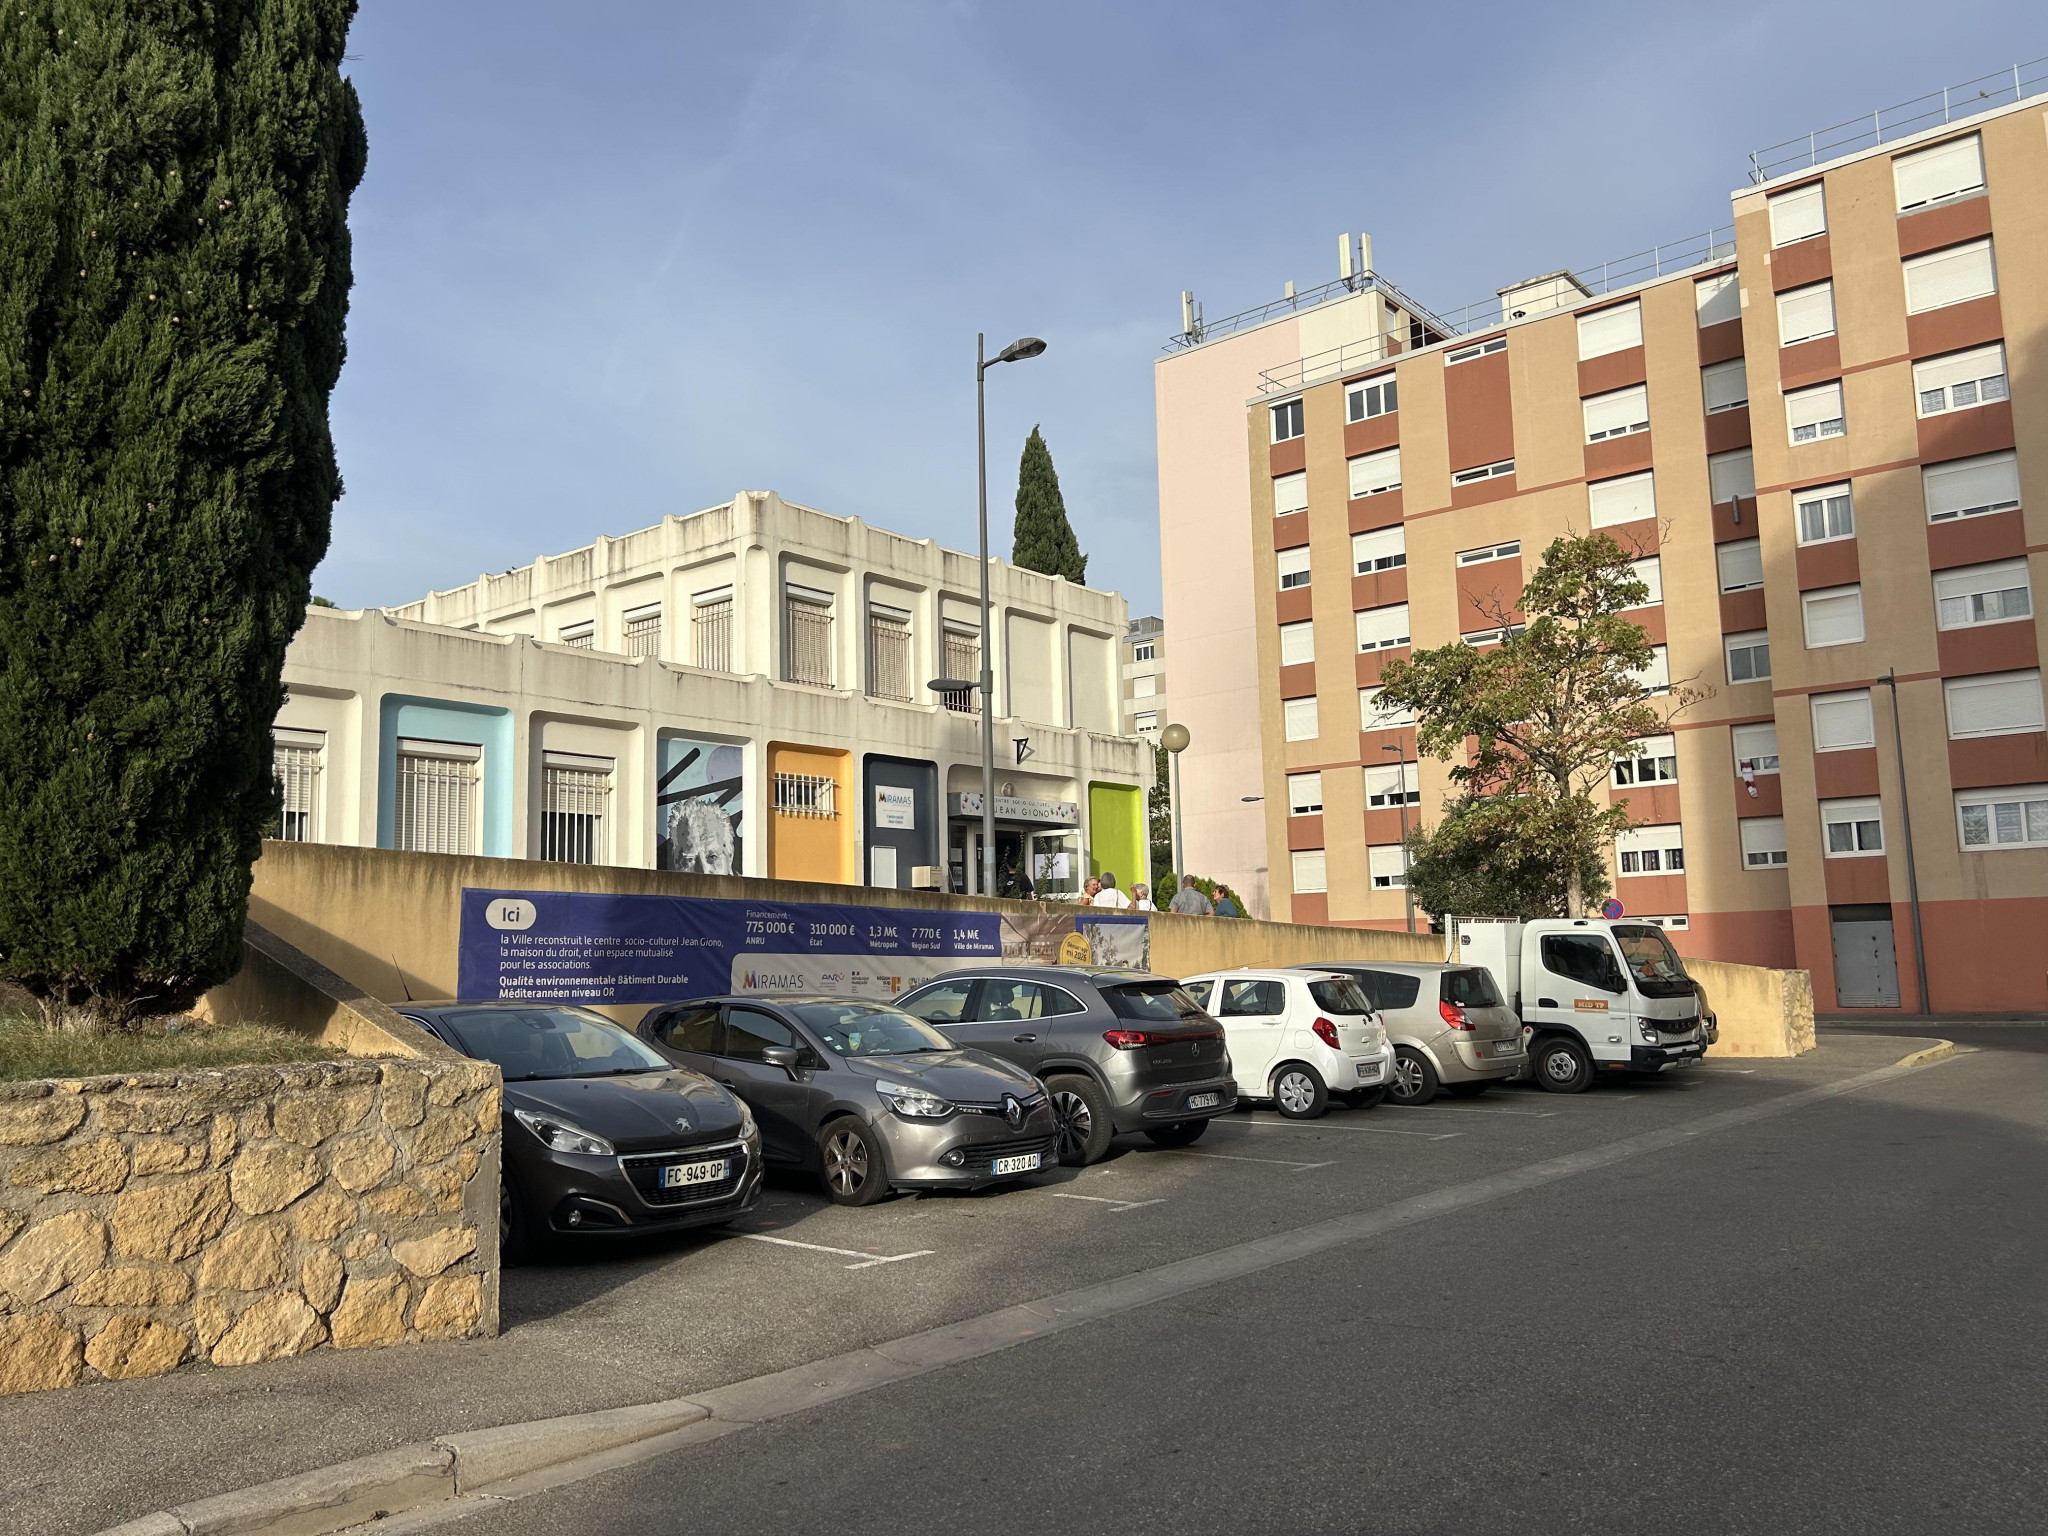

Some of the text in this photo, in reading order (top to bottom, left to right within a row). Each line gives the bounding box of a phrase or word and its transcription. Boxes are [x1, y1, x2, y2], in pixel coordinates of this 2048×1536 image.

[879, 792, 912, 805] MIRAMAS
[994, 806, 1050, 818] JEAN GIONO
[502, 906, 520, 922] Ici
[746, 921, 795, 934] 775 000 €
[810, 923, 855, 936] 310 000 €
[869, 926, 898, 938] 1,3 M€
[919, 928, 934, 939] 770
[935, 928, 941, 939] €
[501, 934, 724, 948] la Ville reconstruit le centre socio-culturel Jean Giono,
[746, 937, 765, 945] ANRU
[953, 929, 980, 941] 1,4 M€
[809, 938, 823, 947] État
[869, 940, 899, 950] Métropole
[911, 942, 941, 951] Région Sud
[954, 942, 995, 950] Ville de Miramas
[500, 946, 674, 959] la maison du droit, et un espace mutualisé
[500, 960, 592, 972] pour les associations.
[500, 974, 689, 988] Qualité environnementale Bâtiment Durable
[742, 970, 804, 989] MIRAMAS
[499, 987, 615, 999] Méditerannéen niveau OR
